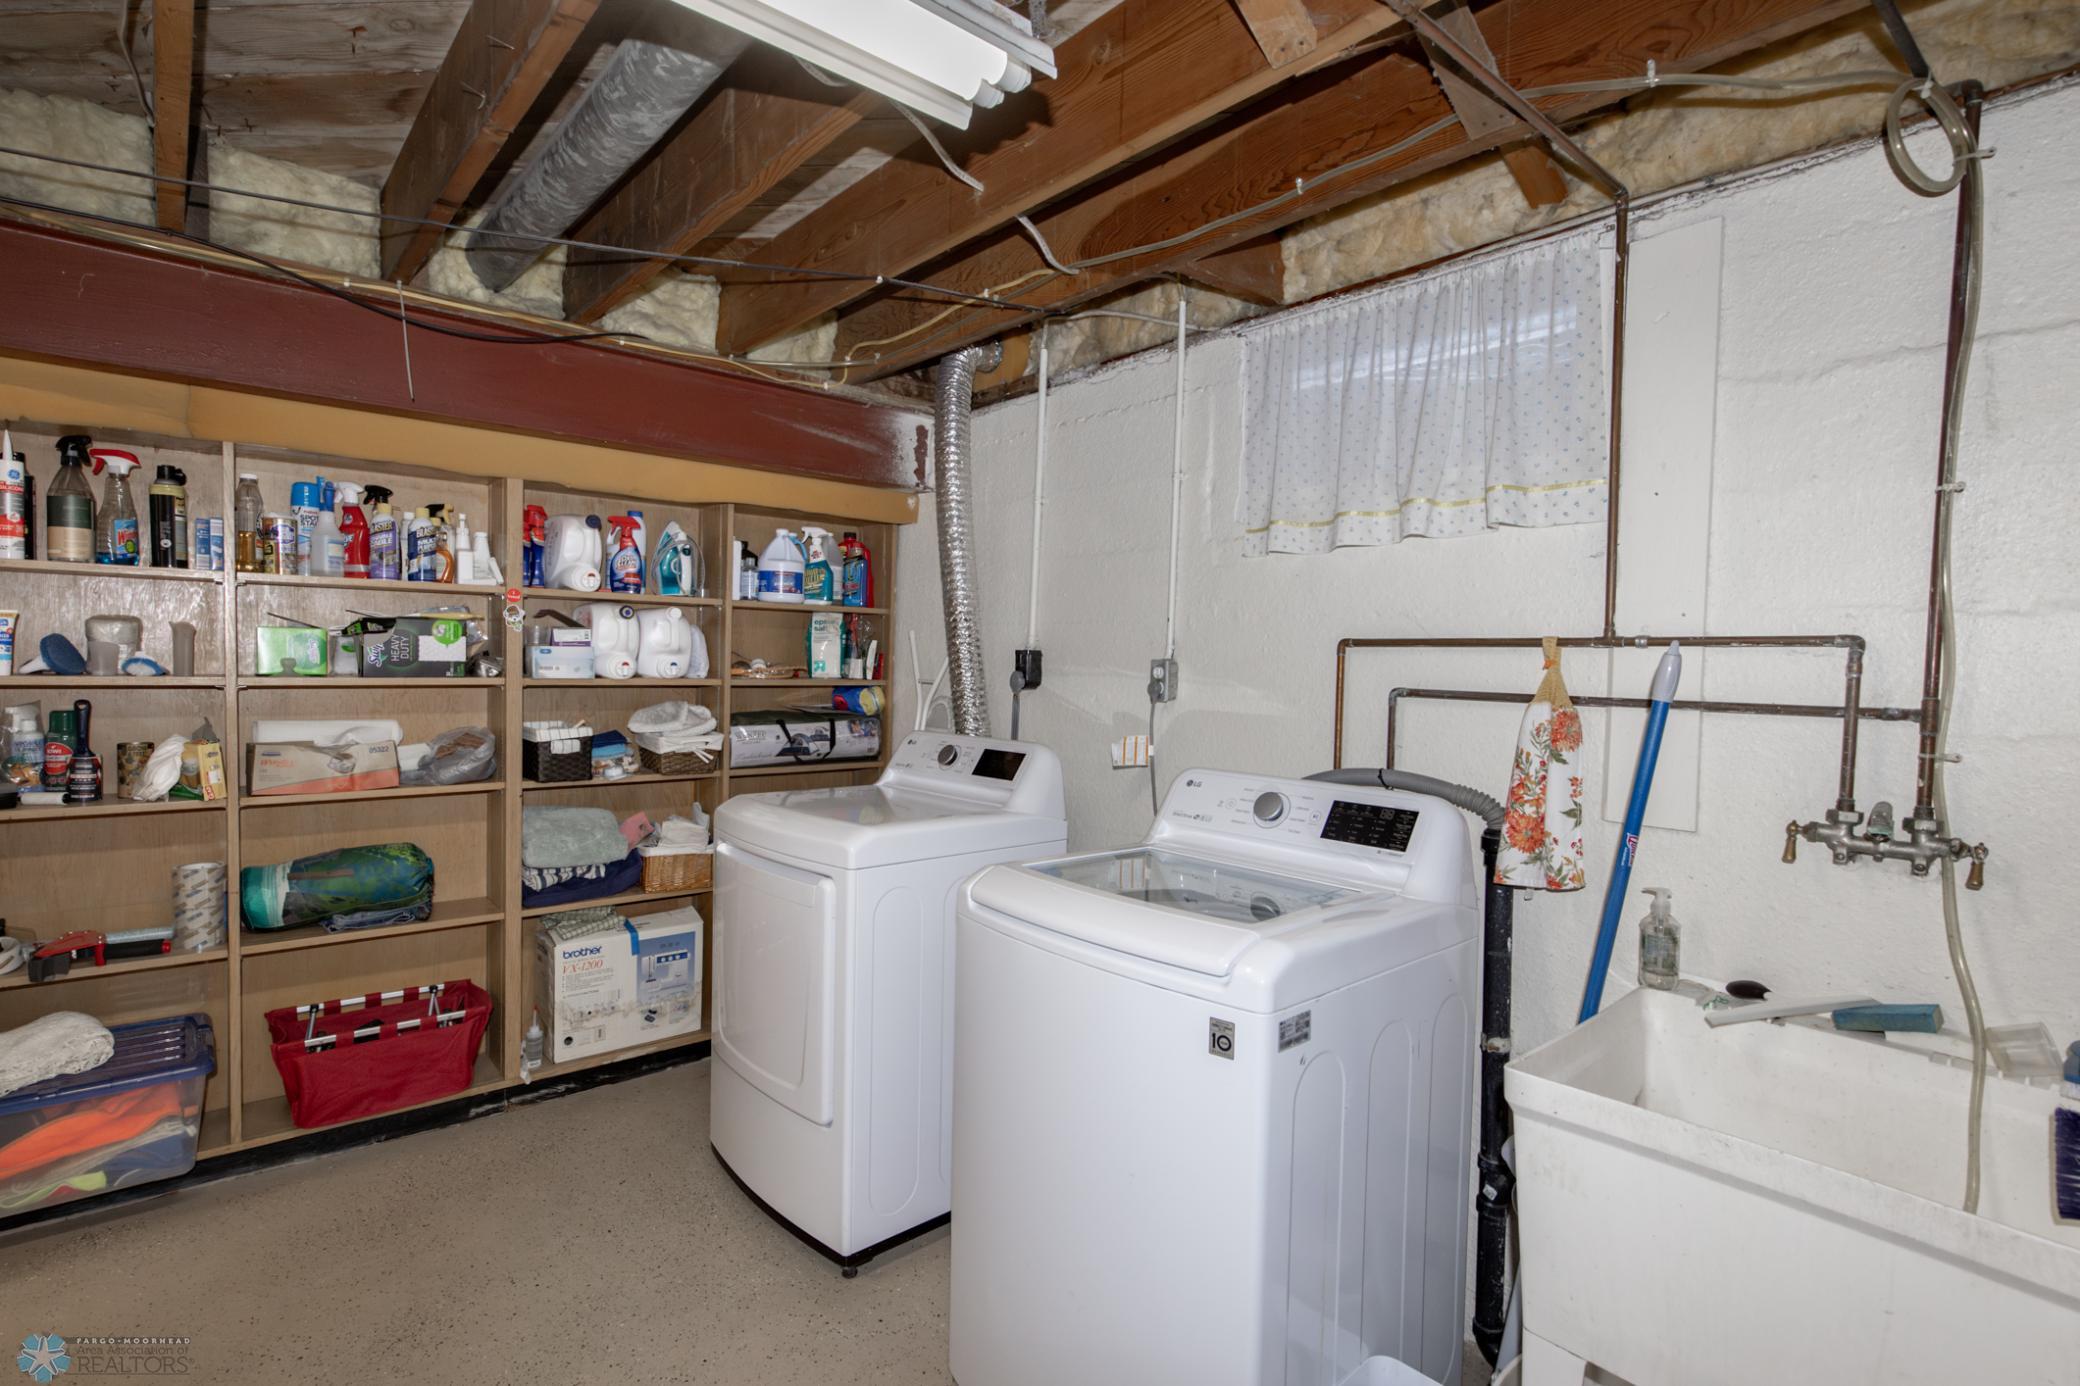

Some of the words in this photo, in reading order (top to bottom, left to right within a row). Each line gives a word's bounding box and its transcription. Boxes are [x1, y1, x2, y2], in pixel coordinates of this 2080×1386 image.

[390, 634, 401, 662] HEAVY
[400, 636, 410, 660] DUTY
[562, 945, 603, 960] brother
